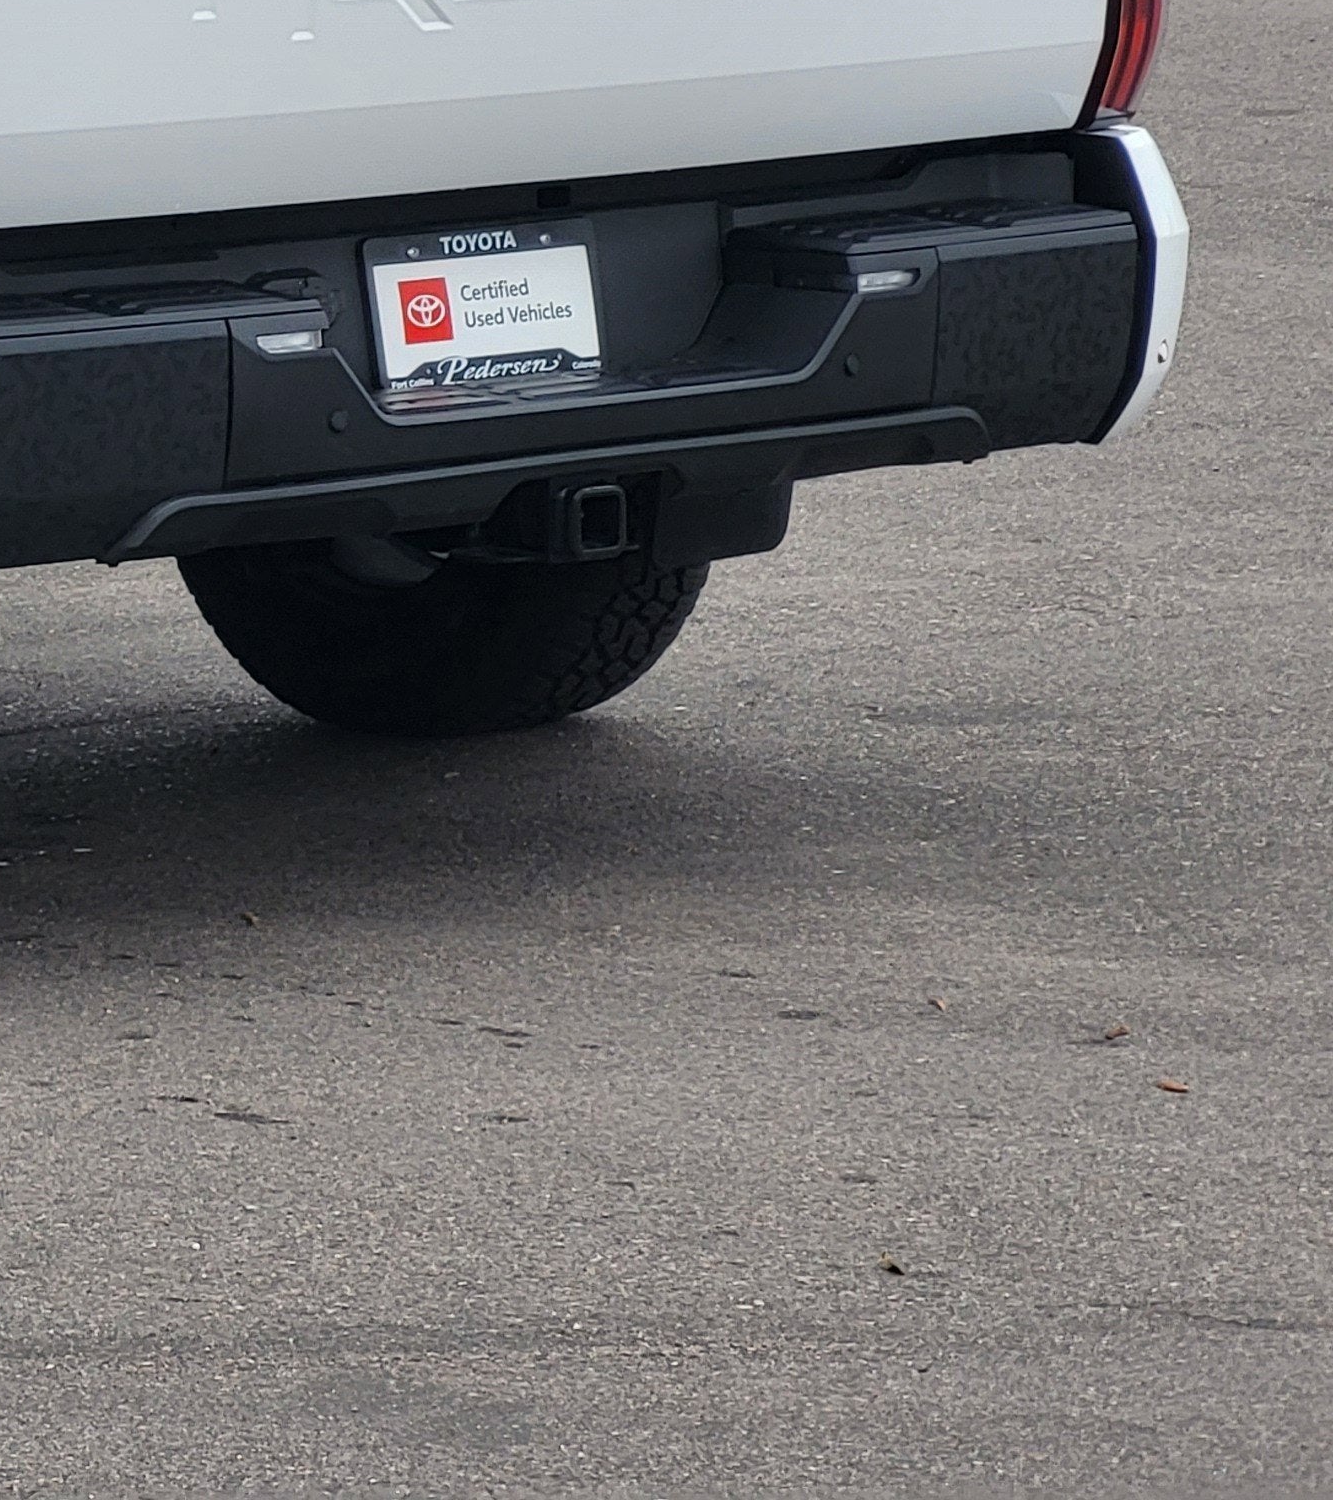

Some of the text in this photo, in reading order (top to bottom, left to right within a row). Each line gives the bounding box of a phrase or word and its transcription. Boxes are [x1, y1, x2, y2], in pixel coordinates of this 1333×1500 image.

[439, 230, 518, 255] TOYOTA
[460, 277, 529, 302] Certified
[464, 301, 573, 328] Used Vehicles
[437, 355, 561, 386] Pedersen
